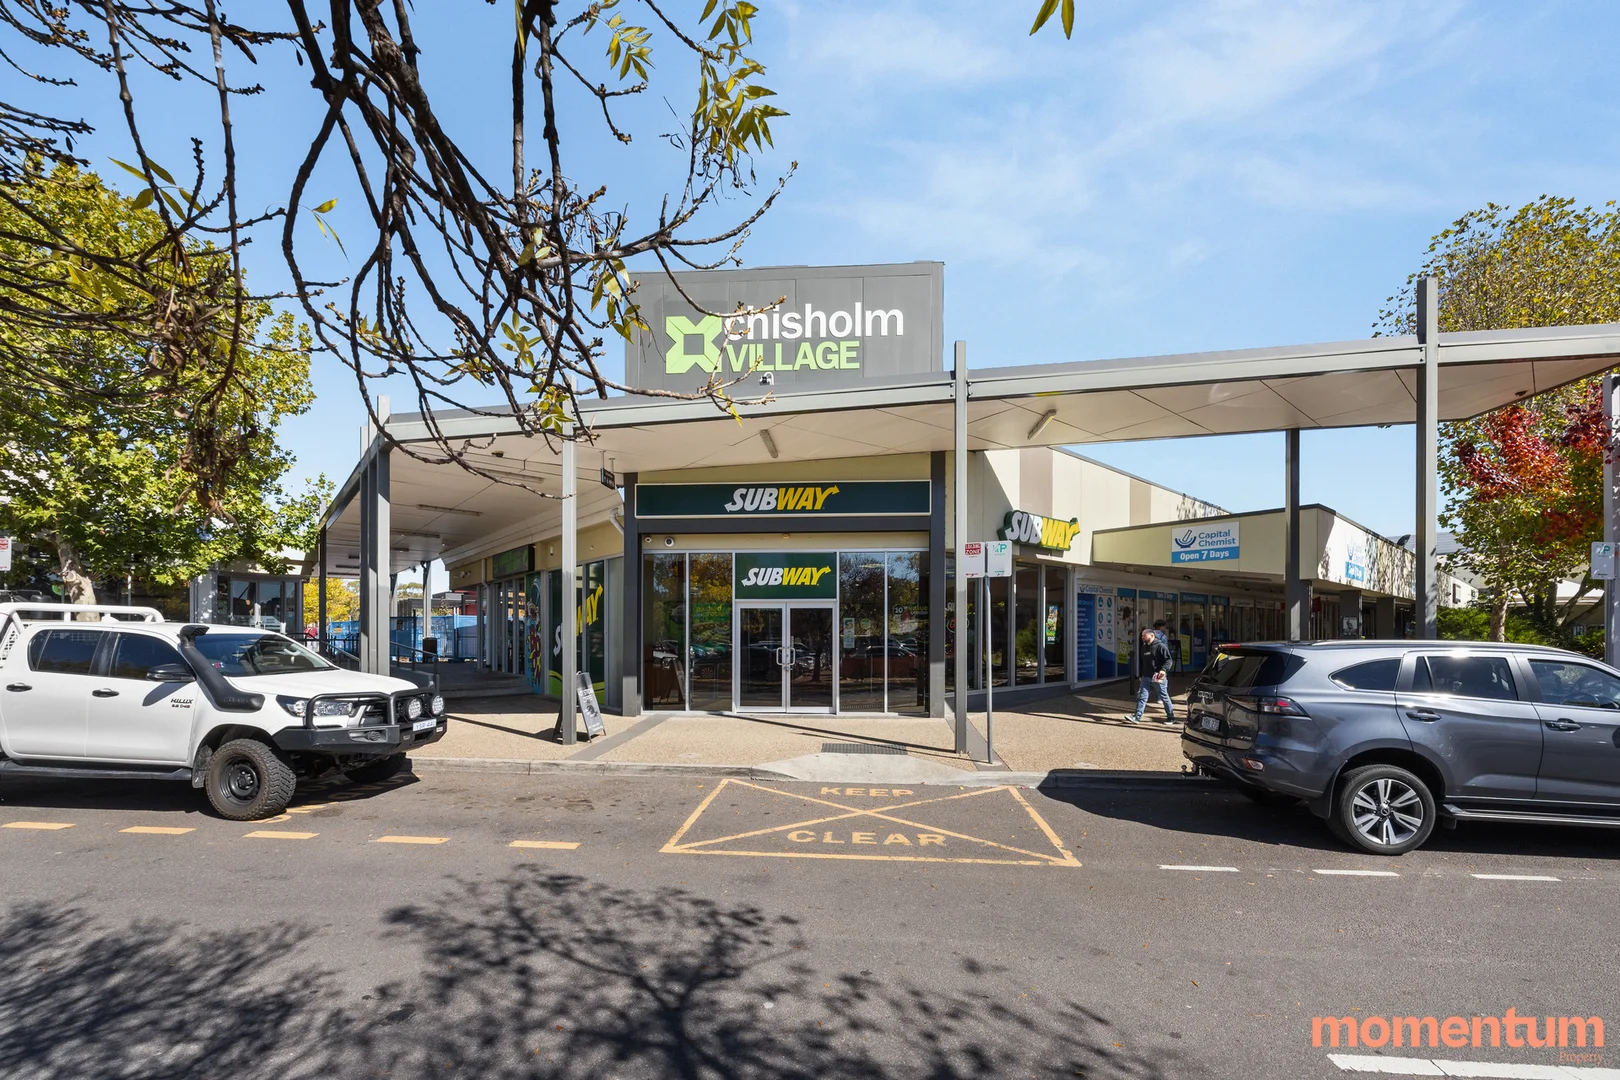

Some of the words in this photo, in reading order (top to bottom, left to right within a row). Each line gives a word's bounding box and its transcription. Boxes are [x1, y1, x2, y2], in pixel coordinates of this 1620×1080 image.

[725, 302, 904, 341] chisholm
[726, 341, 860, 373] VILLAGE
[724, 485, 840, 512] SUBWAY
[1005, 511, 1080, 549] SUBWAY
[1198, 529, 1231, 540] Capital
[1198, 537, 1236, 547] Chemist
[1180, 552, 1200, 561] Open
[1201, 550, 1208, 560] 7
[1209, 550, 1230, 559] Days
[741, 566, 832, 587] SUBWAY
[820, 786, 914, 797] KEEP
[787, 830, 948, 846] CLEAR
